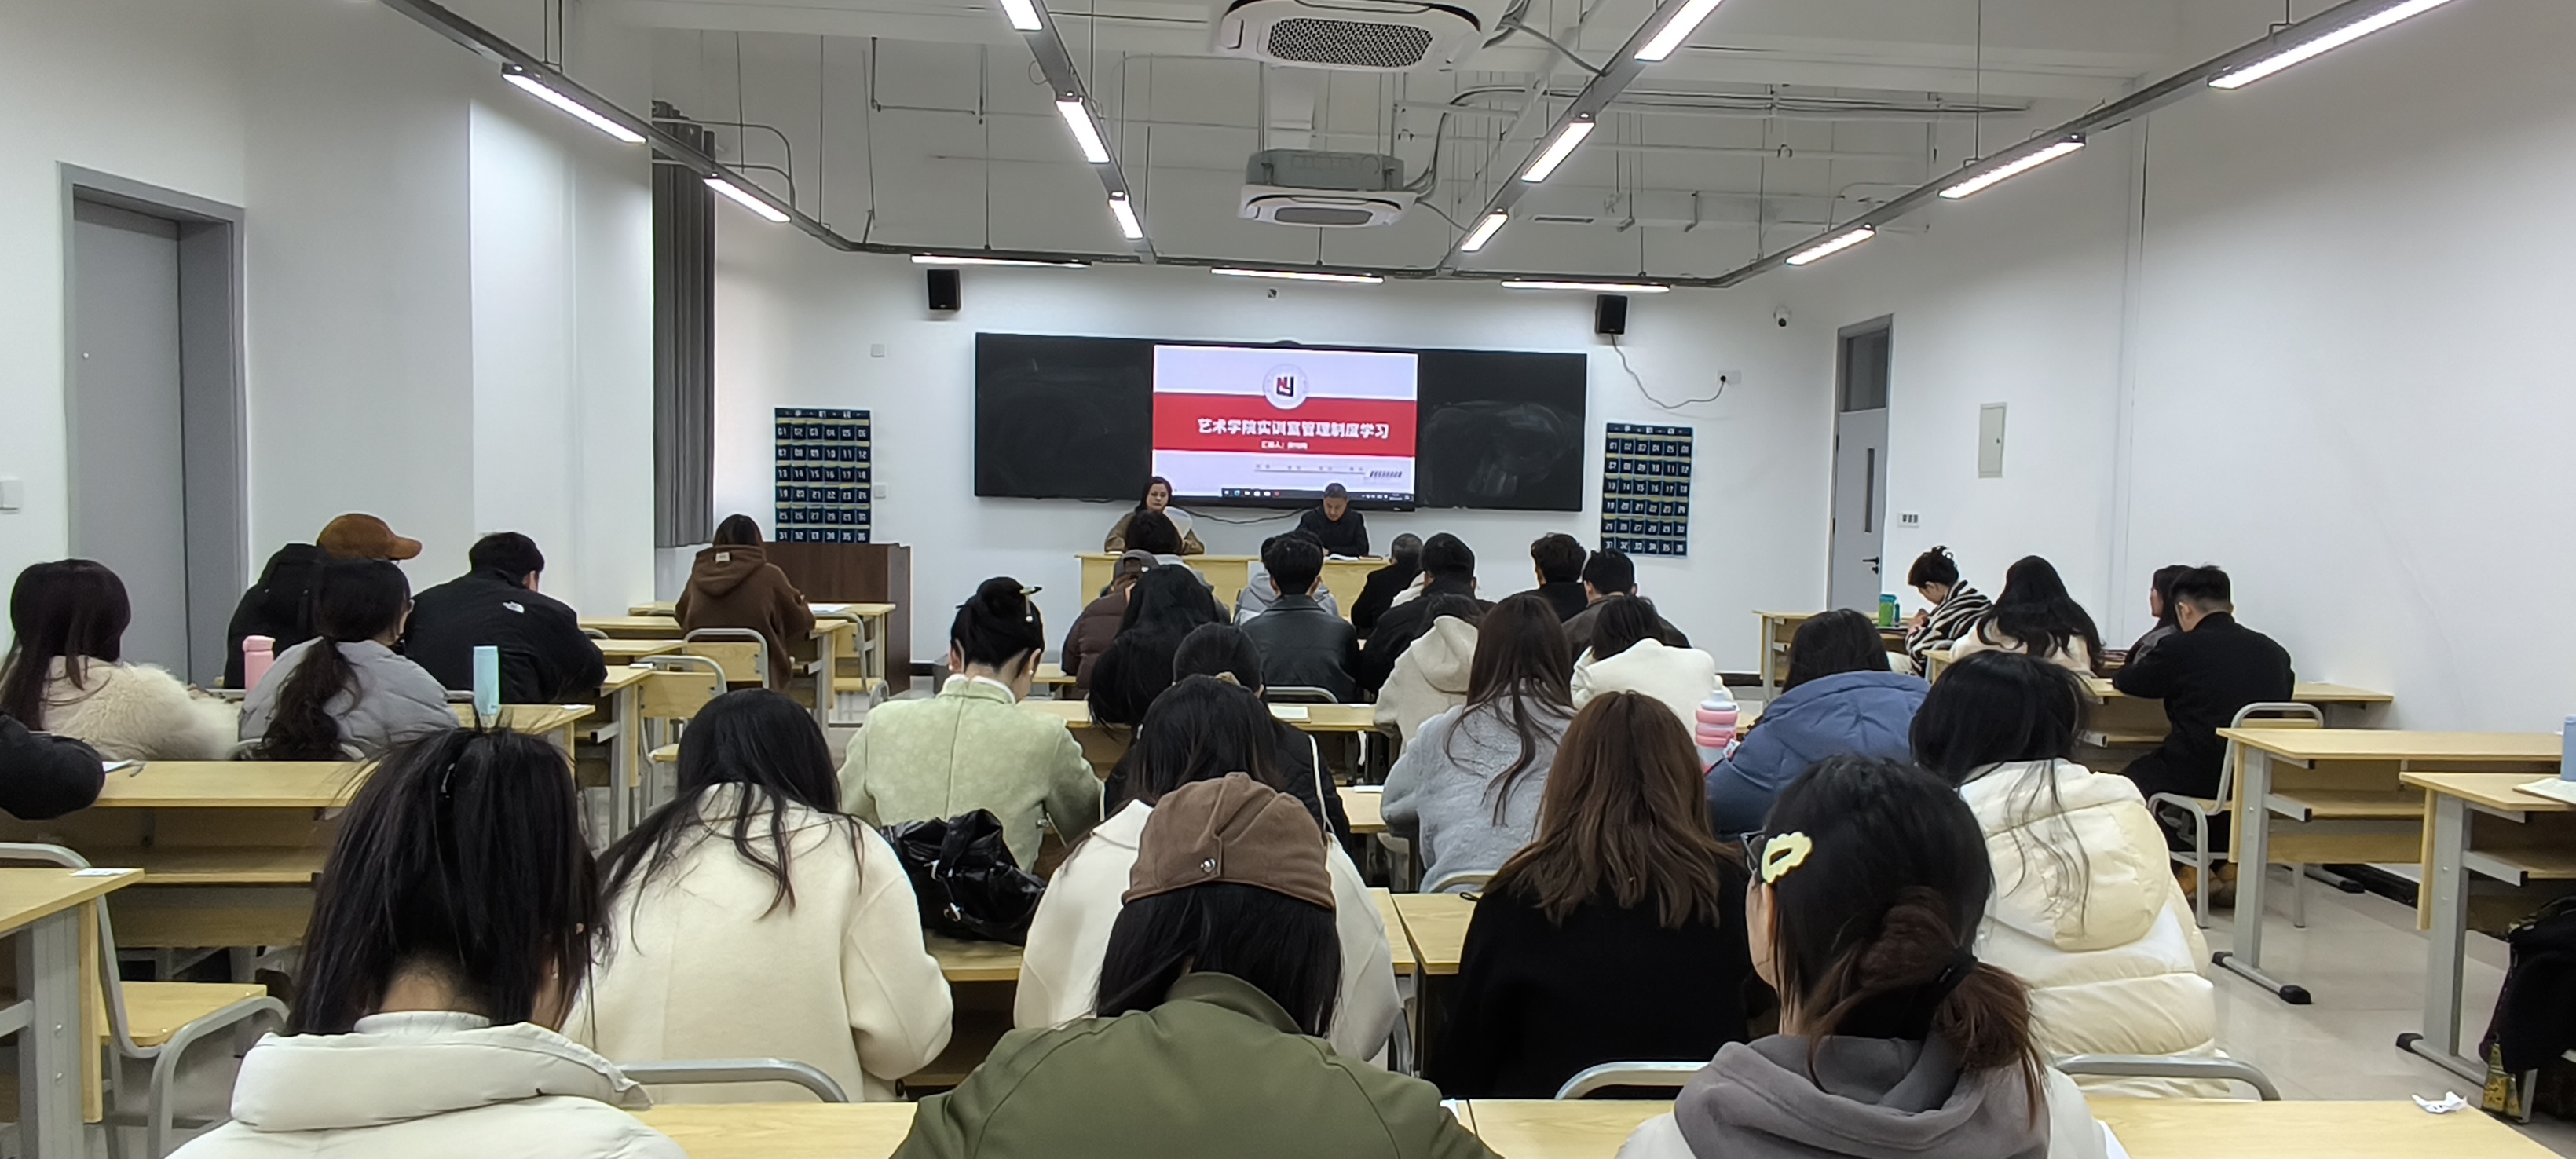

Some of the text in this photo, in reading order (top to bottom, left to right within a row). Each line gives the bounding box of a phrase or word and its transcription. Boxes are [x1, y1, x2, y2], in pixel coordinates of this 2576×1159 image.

[1198, 419, 1390, 439] 艺术学院实训室管理制度学习
